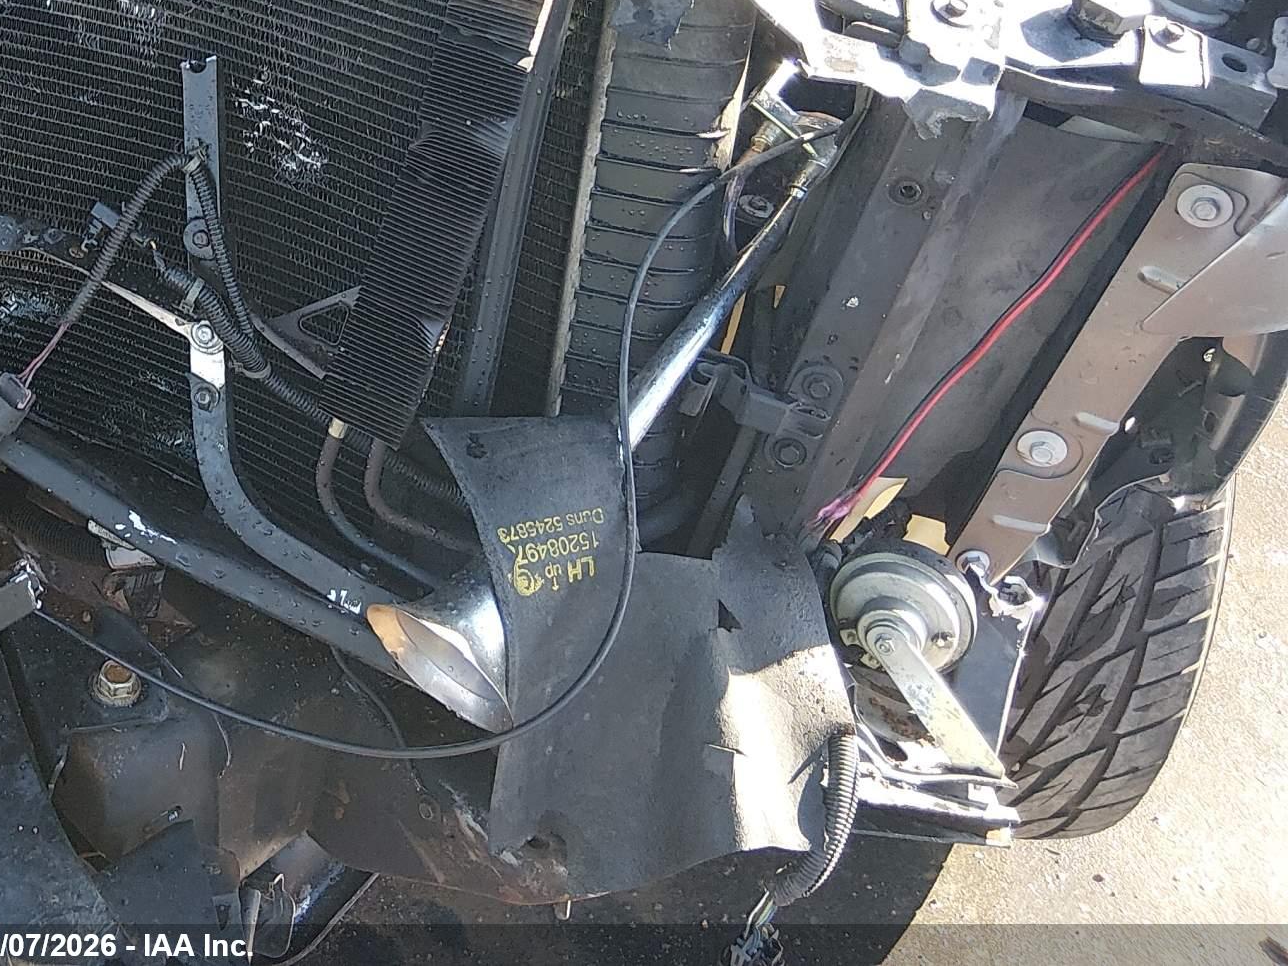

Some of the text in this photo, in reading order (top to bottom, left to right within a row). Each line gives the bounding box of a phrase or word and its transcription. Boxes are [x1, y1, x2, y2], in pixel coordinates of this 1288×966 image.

[566, 508, 604, 525] Duns
[515, 530, 599, 566] 15208497
[567, 556, 595, 583] LH
